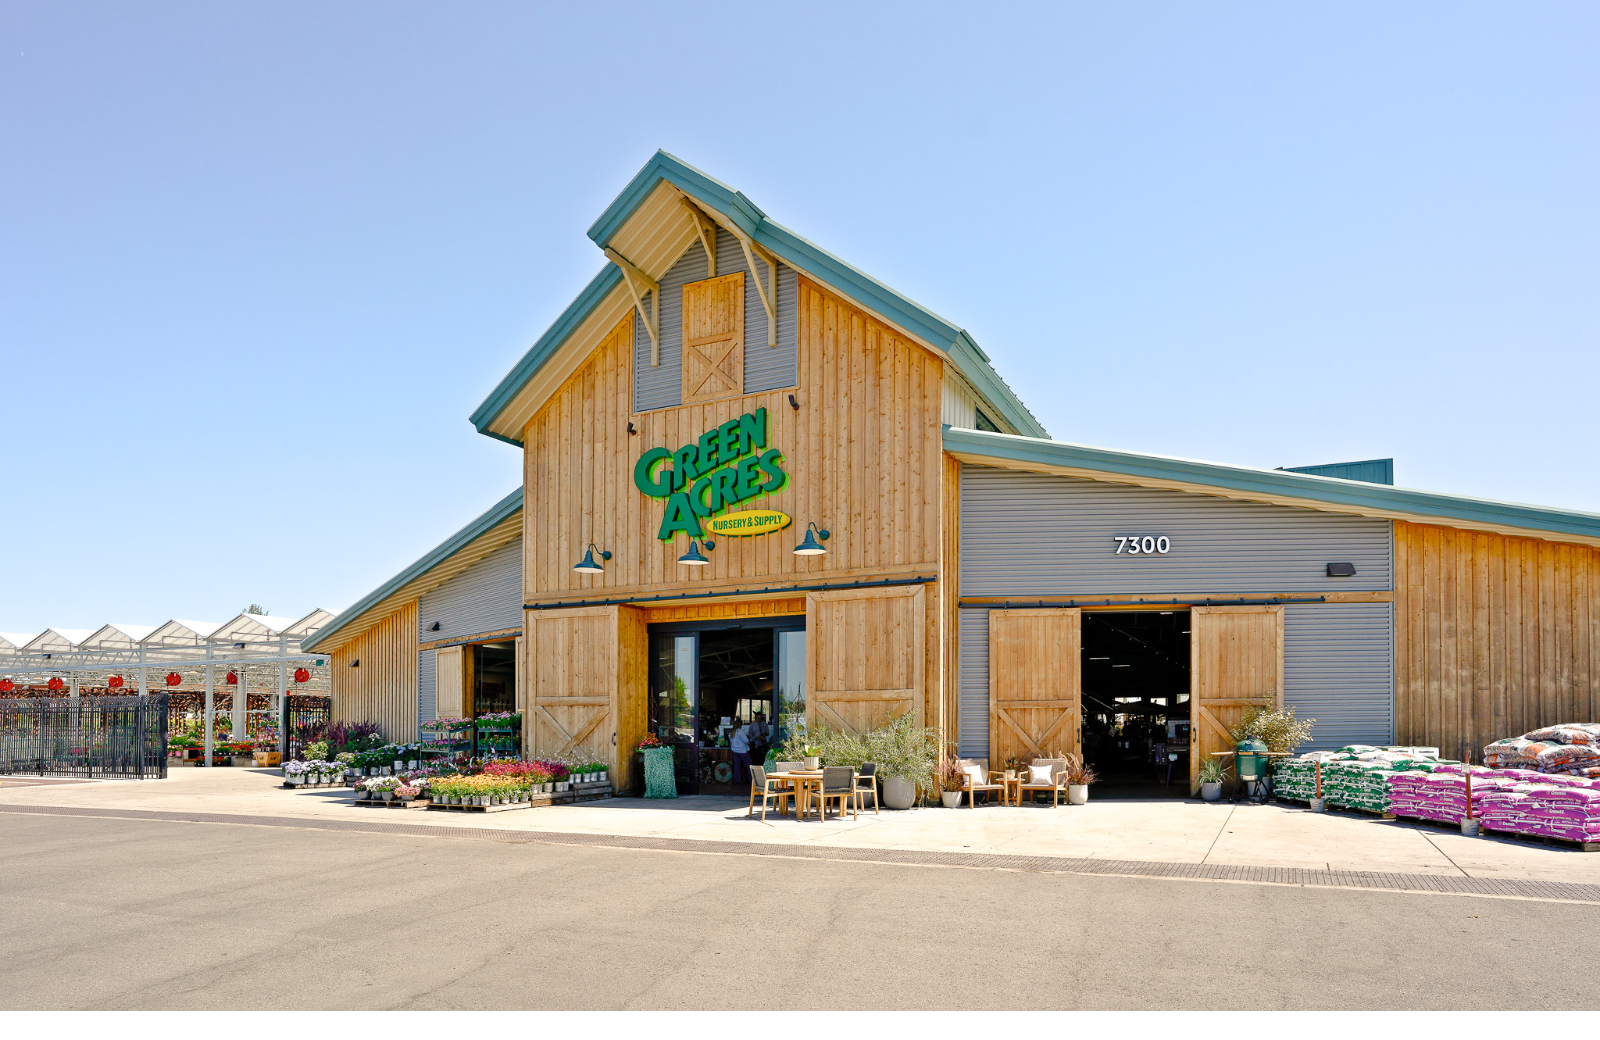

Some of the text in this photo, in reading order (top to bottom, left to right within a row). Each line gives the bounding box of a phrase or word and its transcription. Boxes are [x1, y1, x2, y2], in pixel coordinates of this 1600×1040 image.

[634, 407, 768, 498] GREEN
[657, 448, 787, 541] ACRES
[1114, 535, 1170, 555] 7300
